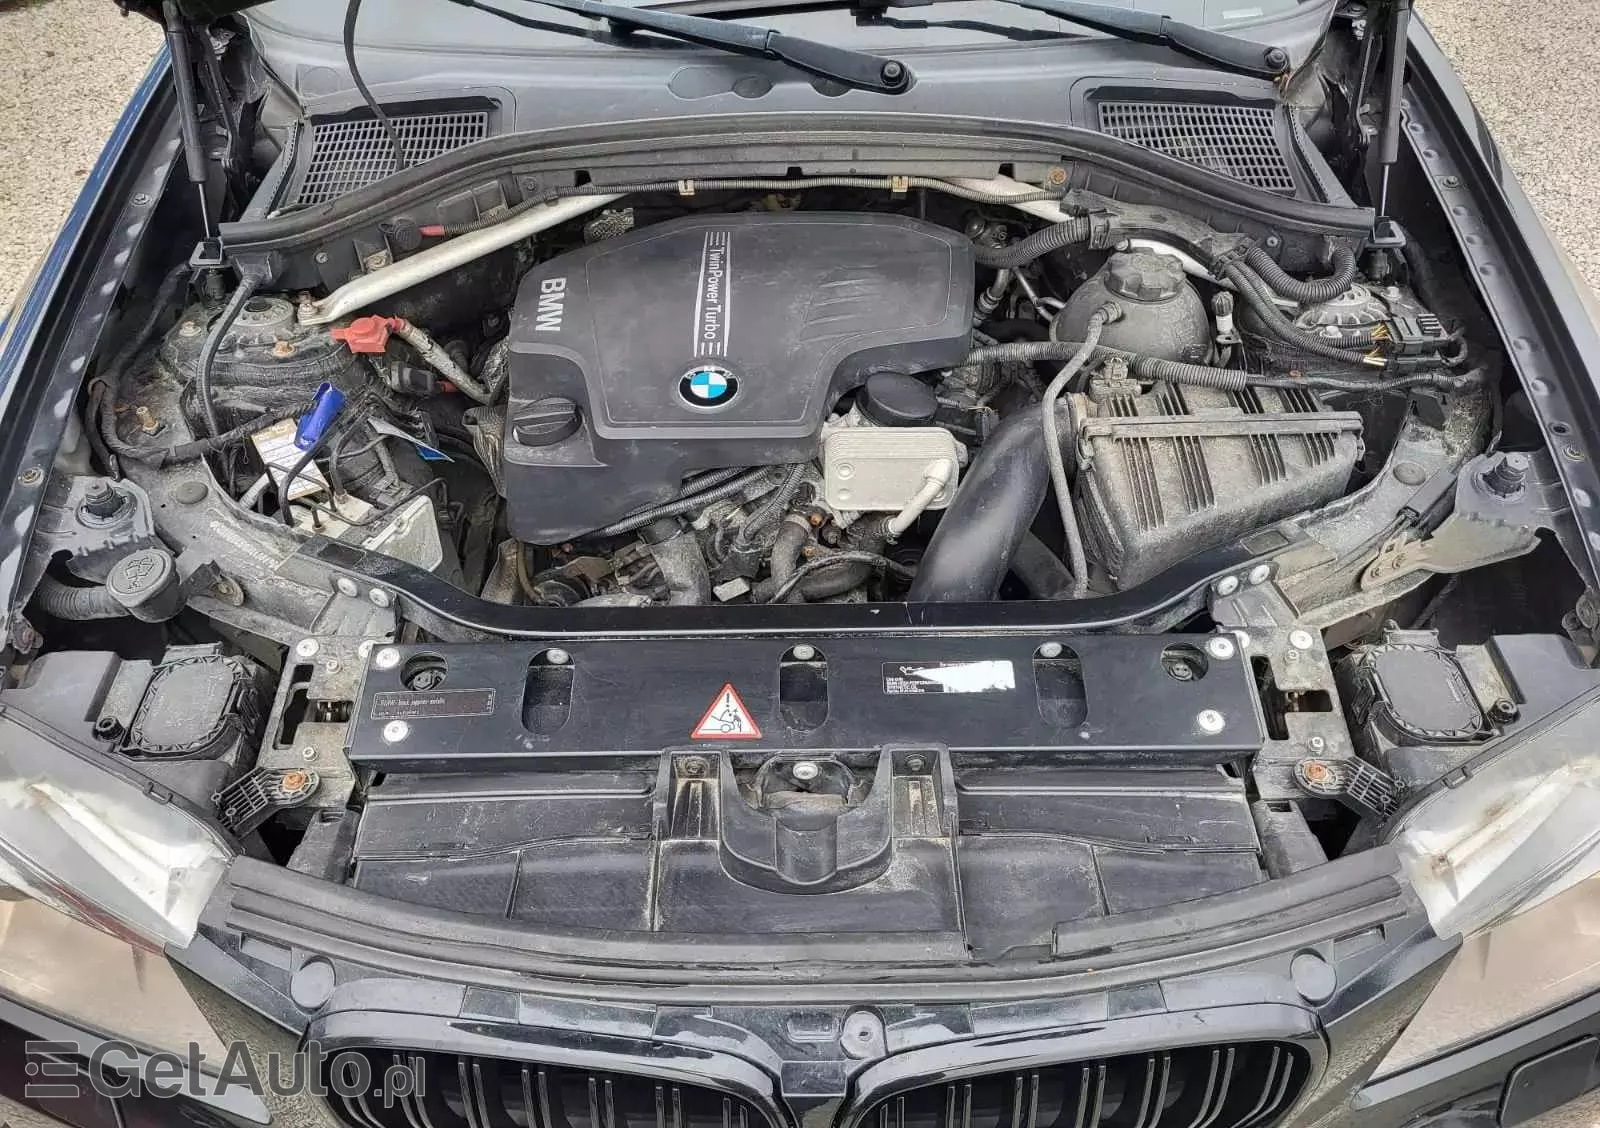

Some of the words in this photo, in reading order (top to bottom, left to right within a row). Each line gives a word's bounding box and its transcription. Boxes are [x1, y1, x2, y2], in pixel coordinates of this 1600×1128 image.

[706, 246, 725, 303] TwinPower
[536, 277, 566, 331] BMW
[703, 305, 722, 340] Turbo
